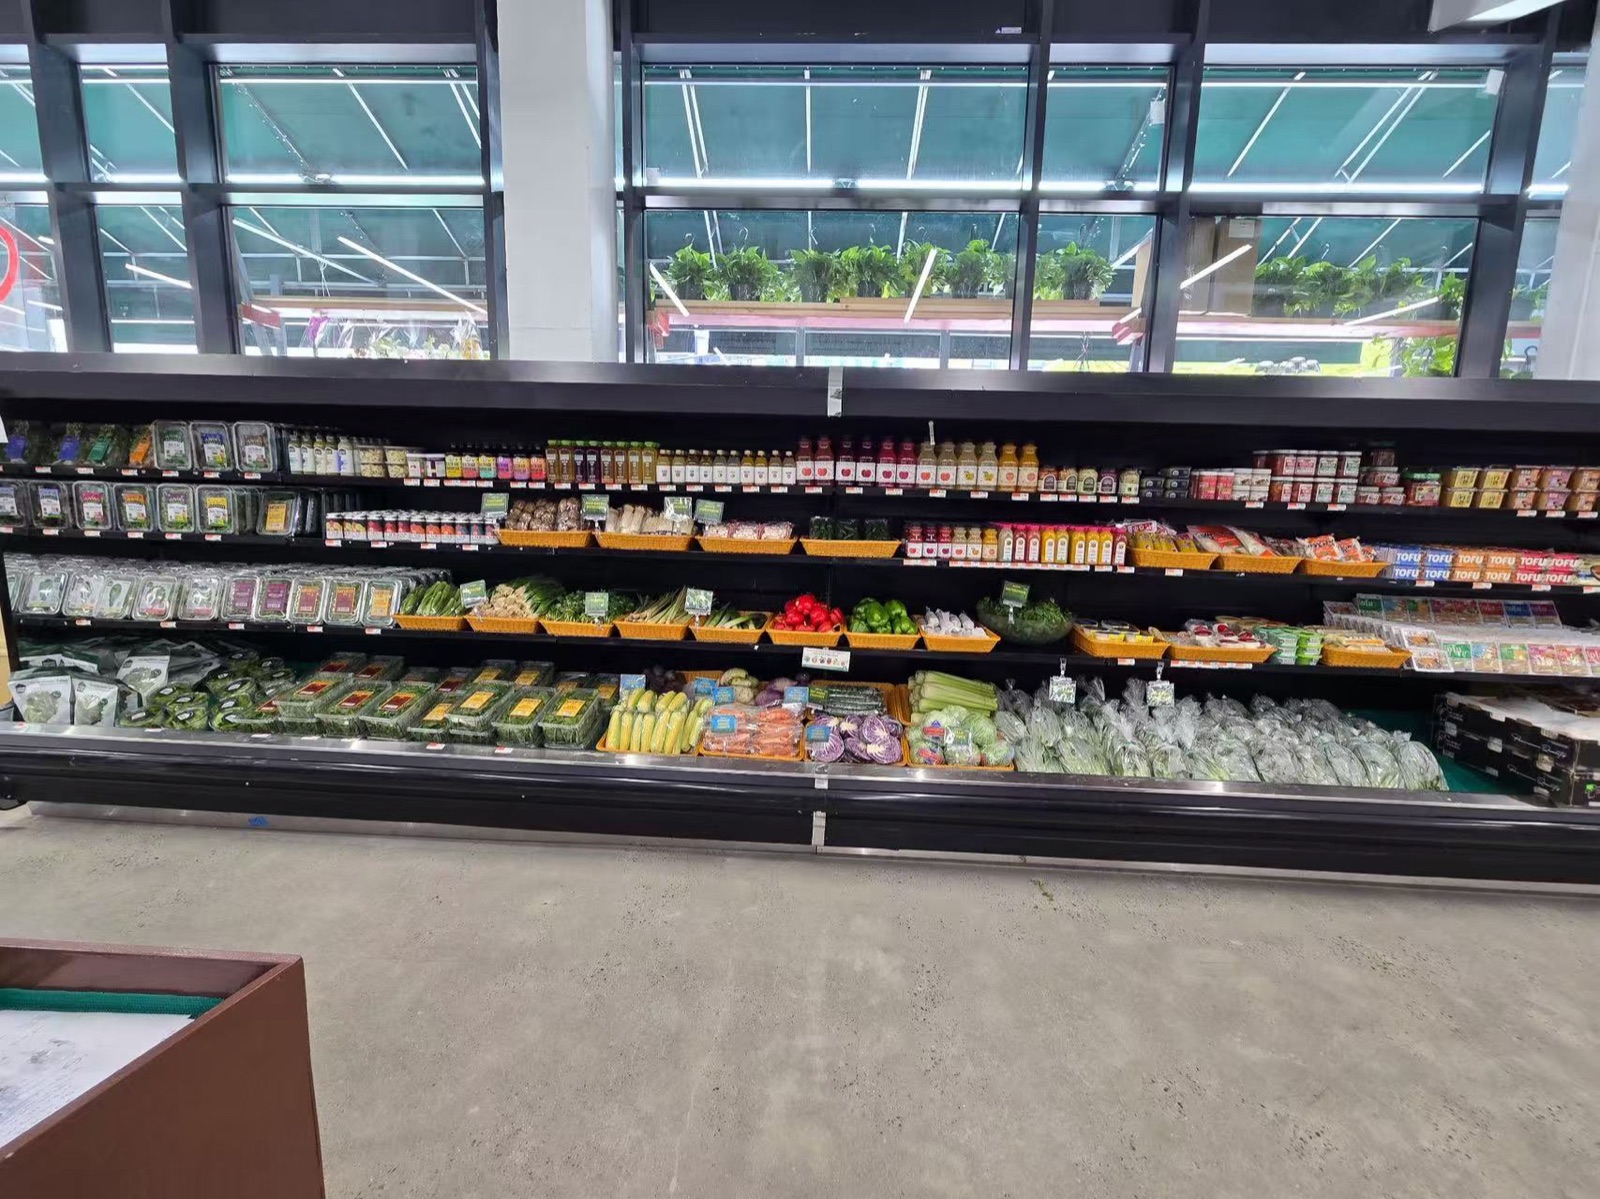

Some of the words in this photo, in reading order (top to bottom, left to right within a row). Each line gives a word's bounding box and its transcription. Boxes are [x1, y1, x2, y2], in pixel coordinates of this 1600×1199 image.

[1397, 553, 1421, 562] TOFU
[1427, 554, 1453, 563] TOFU
[1459, 555, 1483, 564] TOFU
[1490, 556, 1516, 565] TOFU
[1520, 557, 1546, 566] TOFU
[1552, 558, 1578, 568] TOFU
[1394, 568, 1419, 577] TOFU
[1425, 569, 1450, 579] TOFU
[1456, 571, 1480, 580] TOFU
[1485, 572, 1511, 581] TOFU
[1516, 573, 1541, 582] TOFU
[1545, 574, 1572, 583] TOFU
